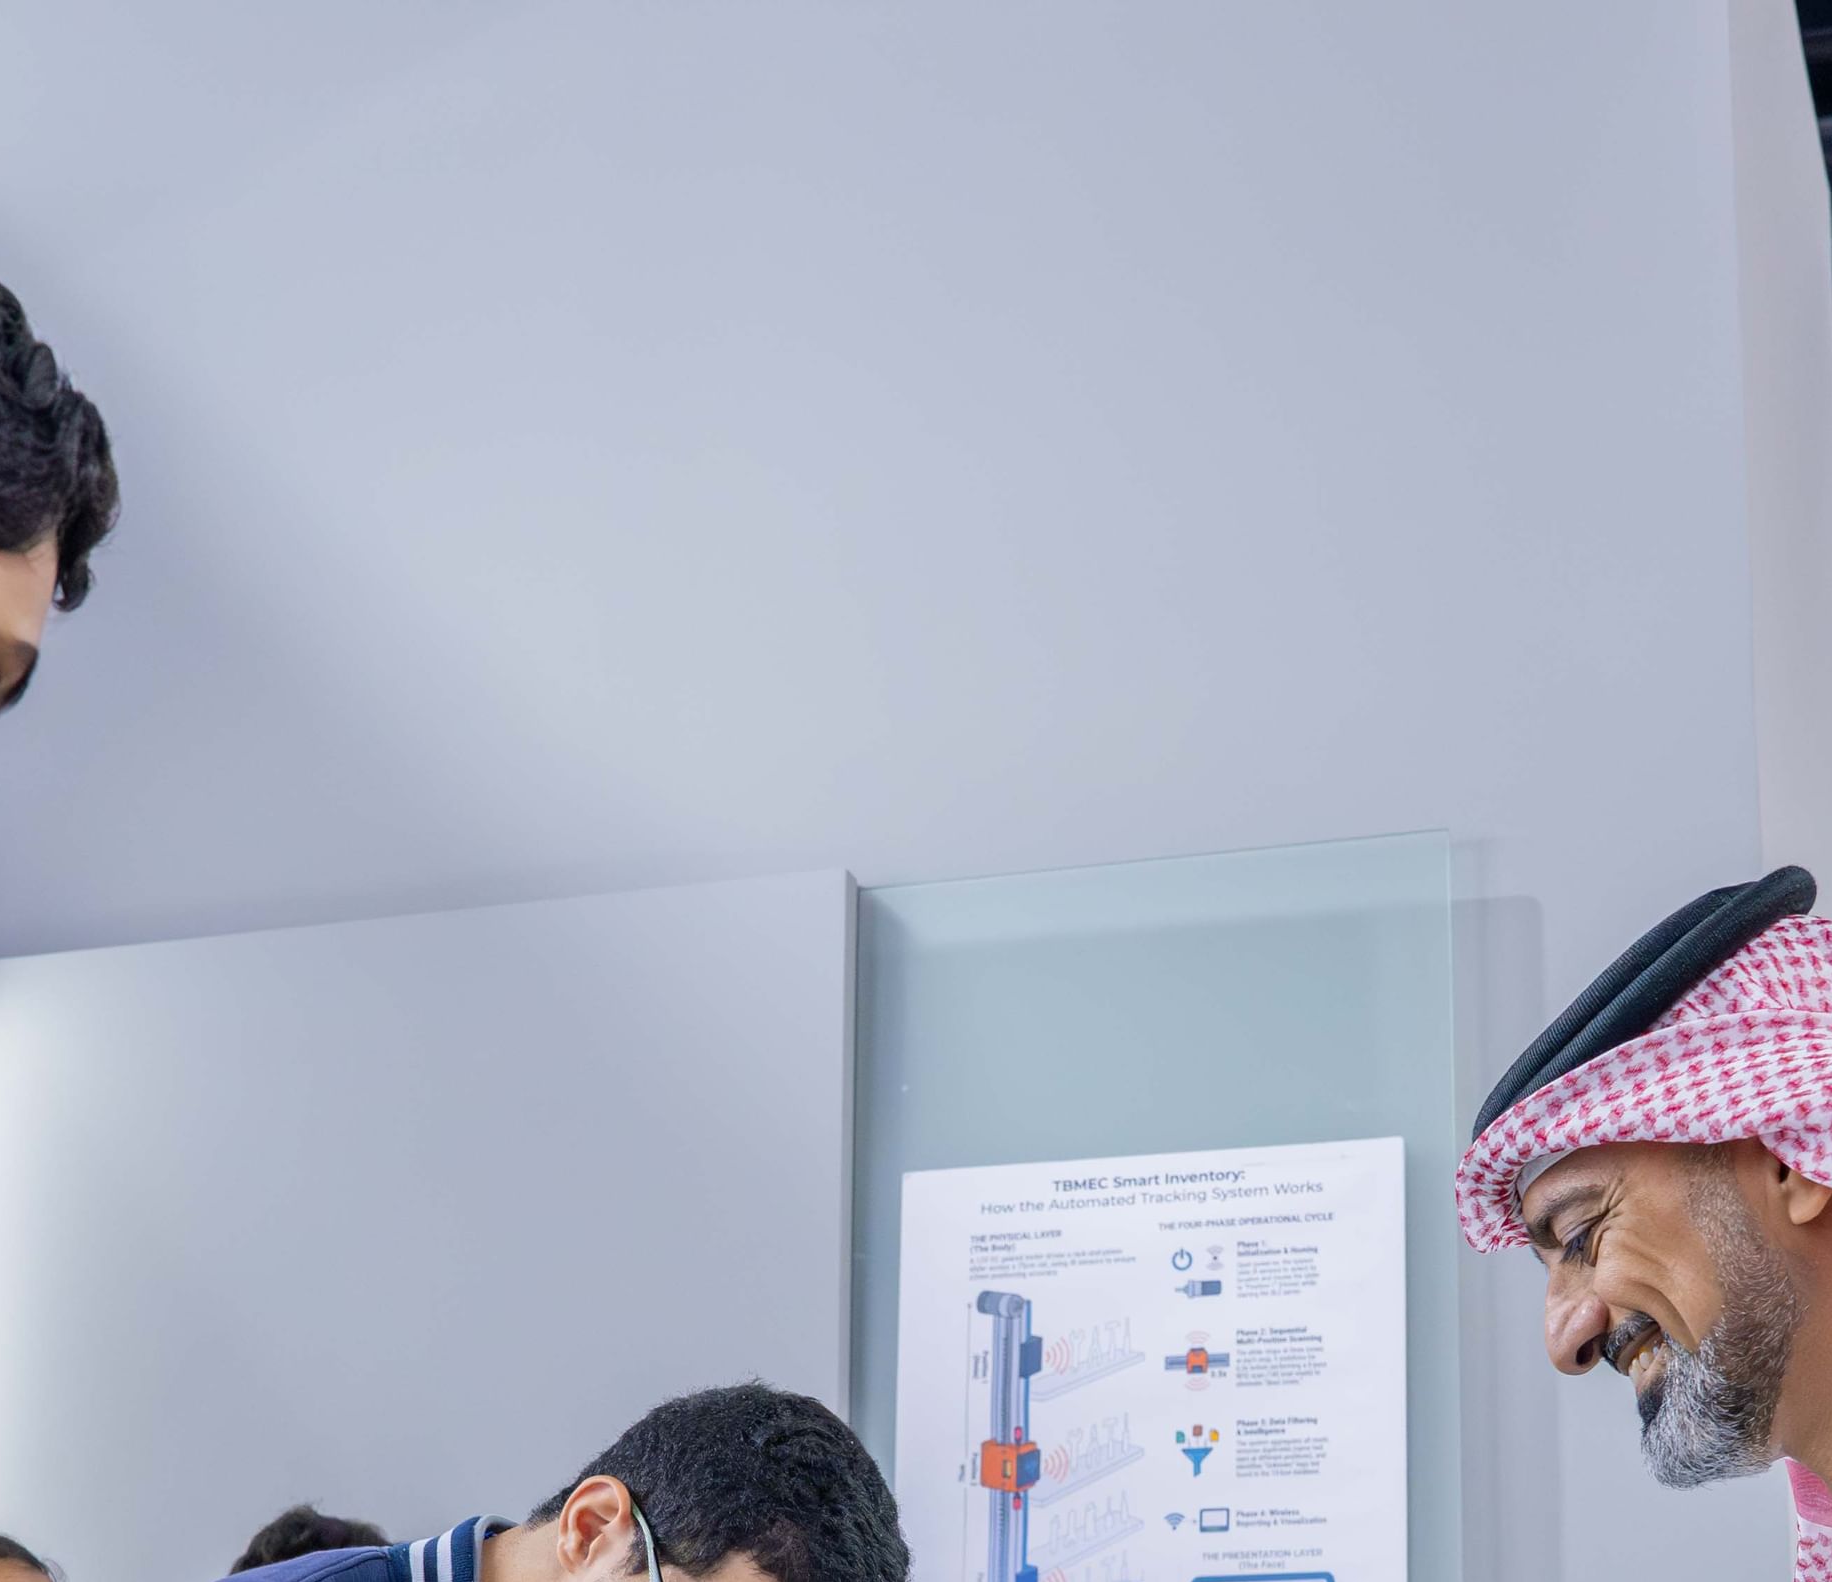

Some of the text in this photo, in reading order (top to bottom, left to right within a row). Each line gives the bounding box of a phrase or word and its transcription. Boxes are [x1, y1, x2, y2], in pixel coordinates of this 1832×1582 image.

[1053, 1169, 1246, 1192] TBMEC Smart Inventory:
[980, 1181, 1324, 1215] How the Automated Tracking System Works
